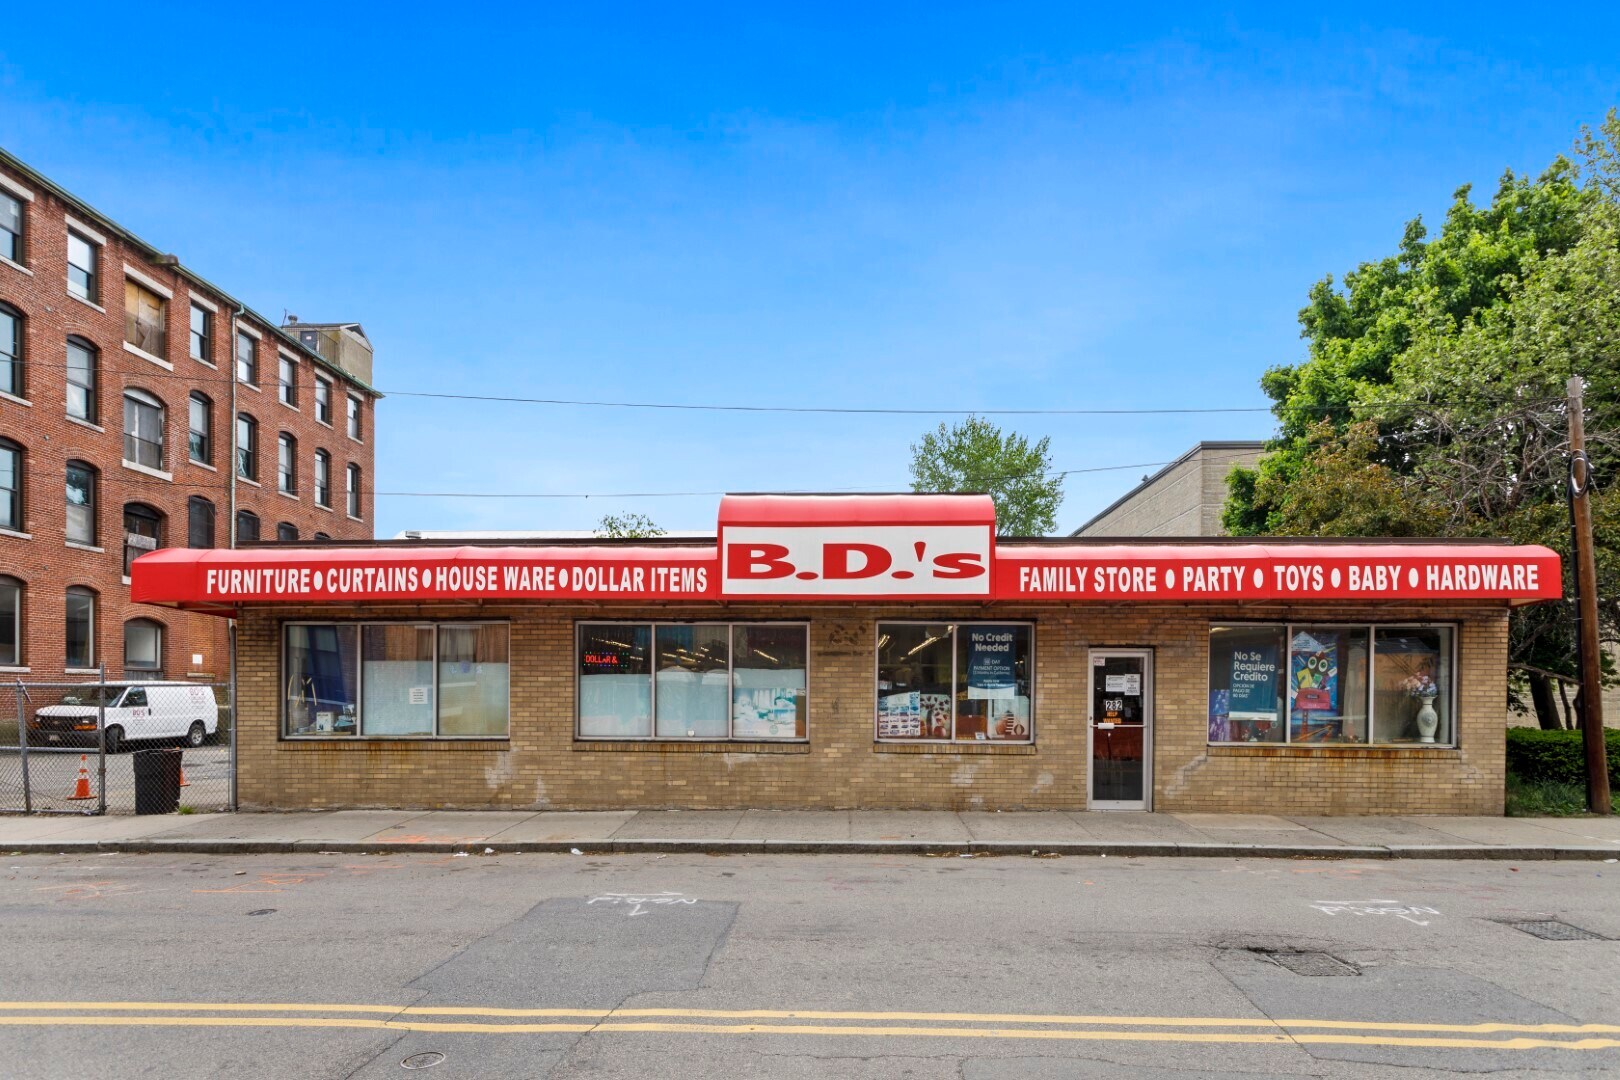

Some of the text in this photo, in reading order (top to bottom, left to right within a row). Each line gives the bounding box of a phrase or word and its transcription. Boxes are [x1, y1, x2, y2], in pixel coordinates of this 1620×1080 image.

[727, 541, 986, 580] B.D.'s
[206, 566, 707, 594] FURNITURE CURTAINS HOUSE WARE DOLLAR ITEMS
[1019, 565, 1539, 593] FAMILY STORE PARTY TOYS BABY HARDWARE
[972, 633, 1013, 642] No Credit
[975, 643, 1009, 651] Needed
[585, 655, 611, 664] DOLLAR
[1234, 651, 1262, 661] No Se
[1233, 661, 1275, 673] Requiere
[1106, 700, 1122, 710] 282
